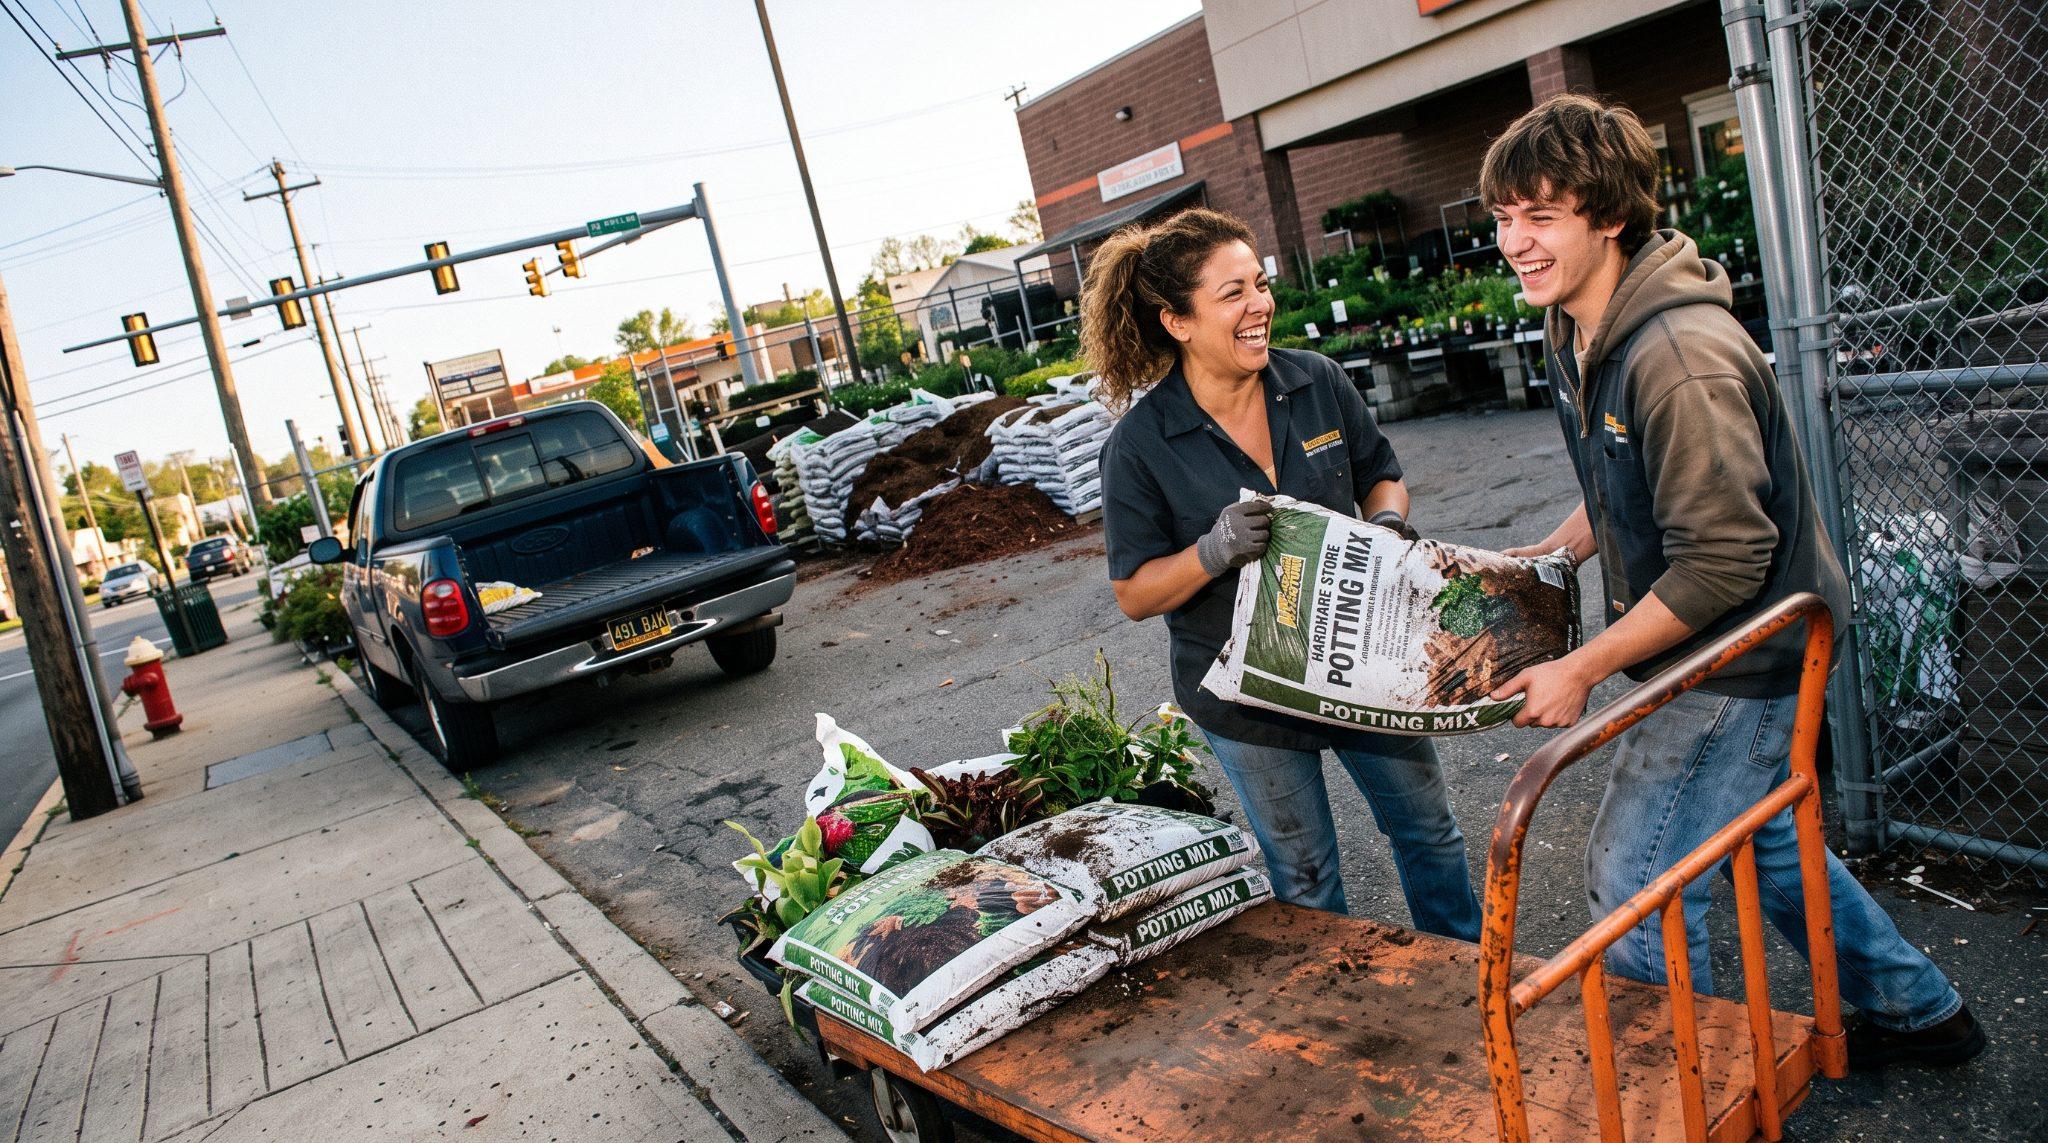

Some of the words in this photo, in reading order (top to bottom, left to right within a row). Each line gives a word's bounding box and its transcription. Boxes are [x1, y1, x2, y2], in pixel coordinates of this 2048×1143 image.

[1320, 544, 1341, 585] STORE
[1342, 531, 1373, 574] MIX
[615, 621, 638, 641] 491
[641, 610, 667, 633] BAK
[1326, 578, 1364, 688] POTTING
[1318, 700, 1424, 731] POTTING
[1433, 710, 1480, 731] MIX
[1111, 852, 1186, 894] POTTING
[1184, 840, 1220, 865] MIX
[1136, 899, 1207, 943] POTTING
[1208, 884, 1241, 911] MIX
[844, 975, 861, 996] MIX
[831, 995, 866, 1025] POTTING
[867, 1014, 884, 1035] MIX
